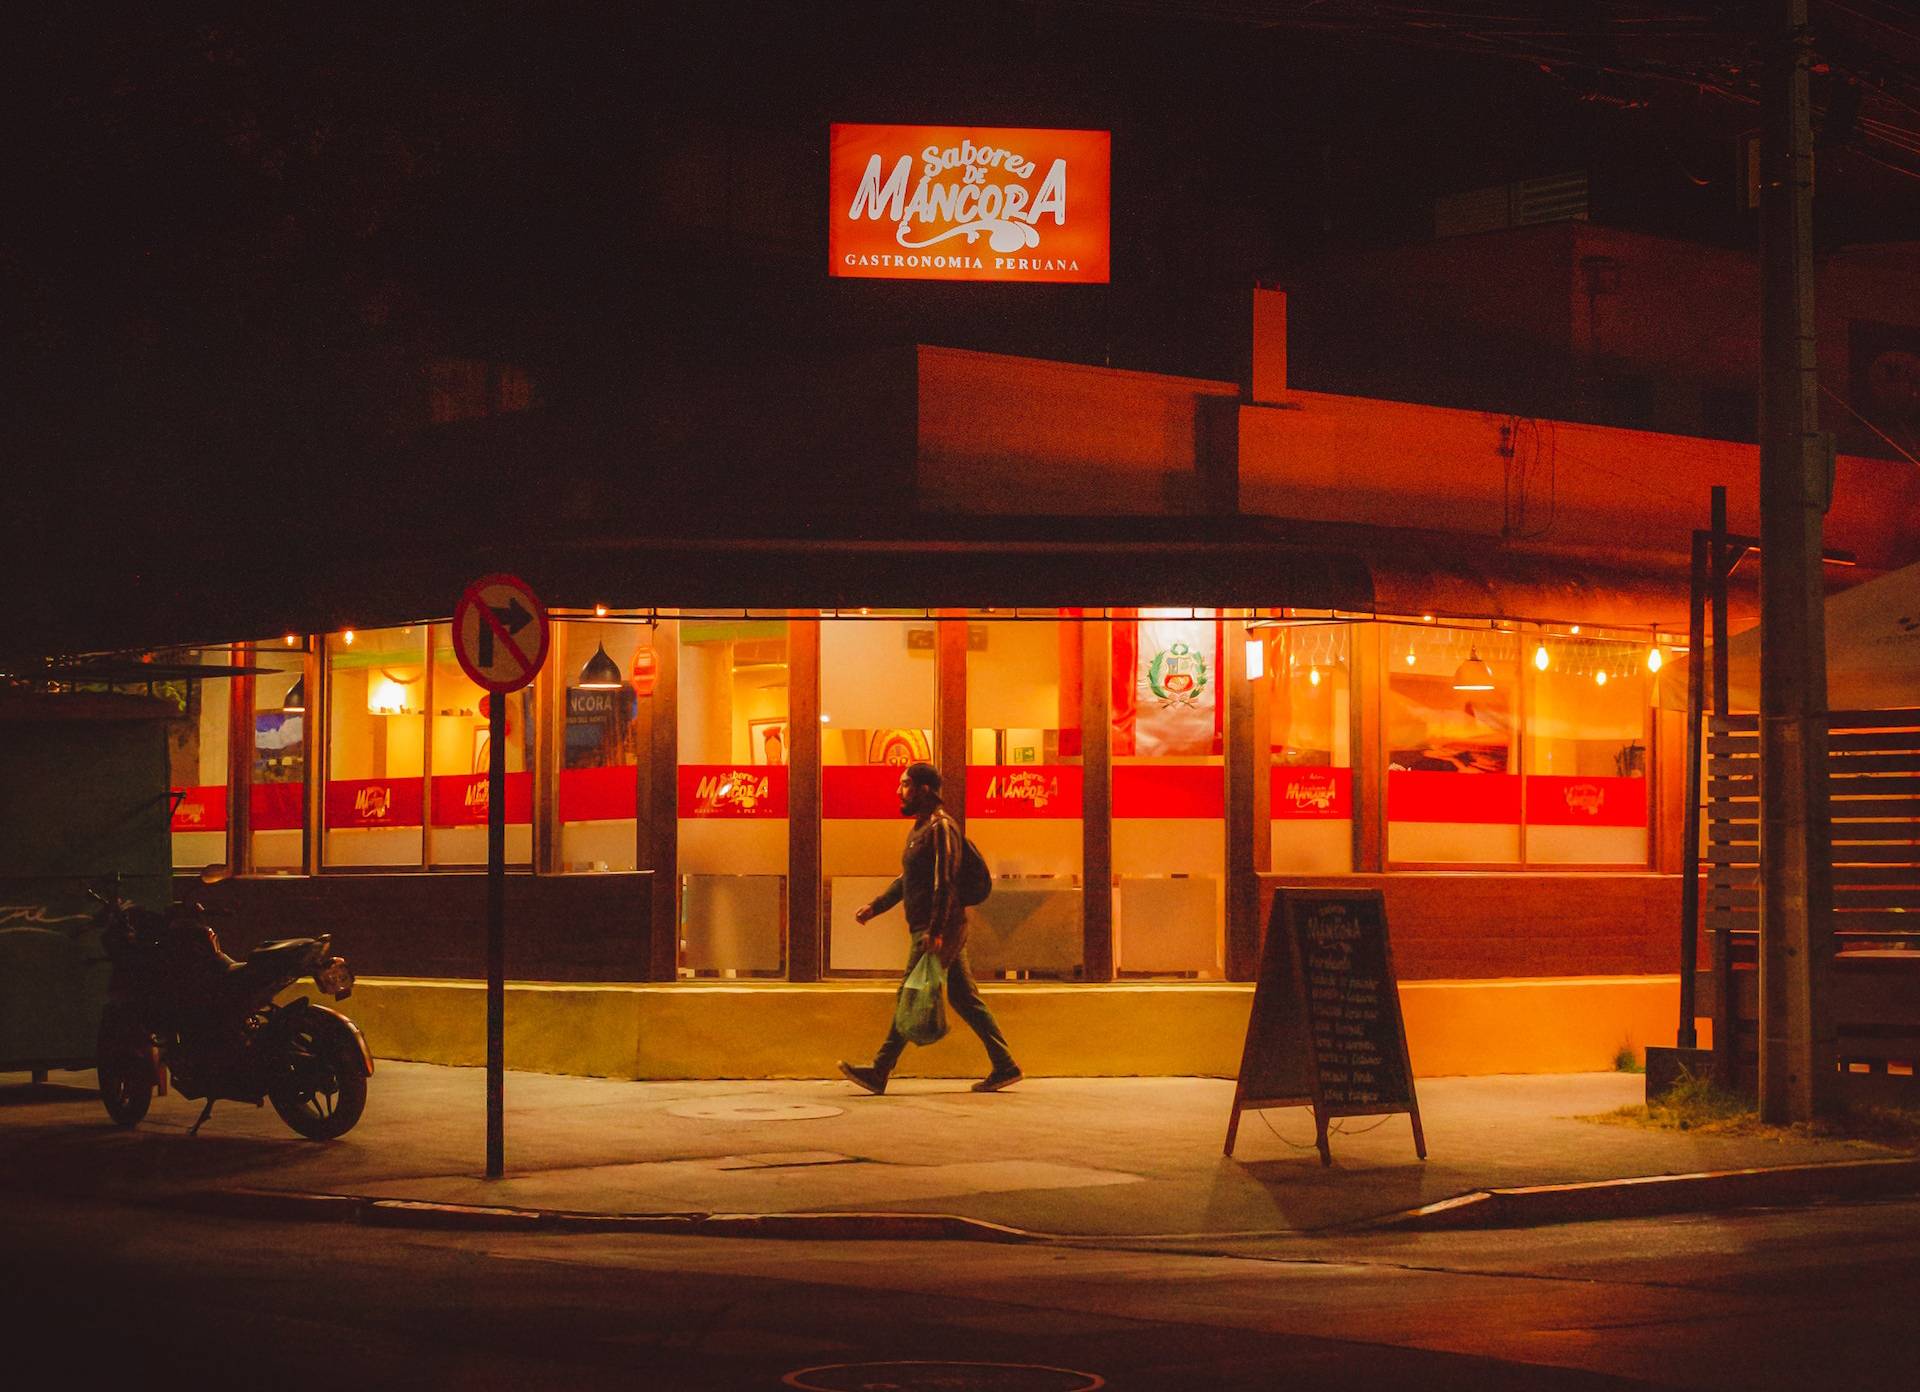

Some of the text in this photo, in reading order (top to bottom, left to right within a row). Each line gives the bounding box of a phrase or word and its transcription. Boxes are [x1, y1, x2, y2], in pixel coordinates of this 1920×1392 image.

[922, 139, 1036, 179] Sabores
[963, 165, 988, 184] DE
[845, 253, 1080, 272] GASTRONOMIA PERUANA
